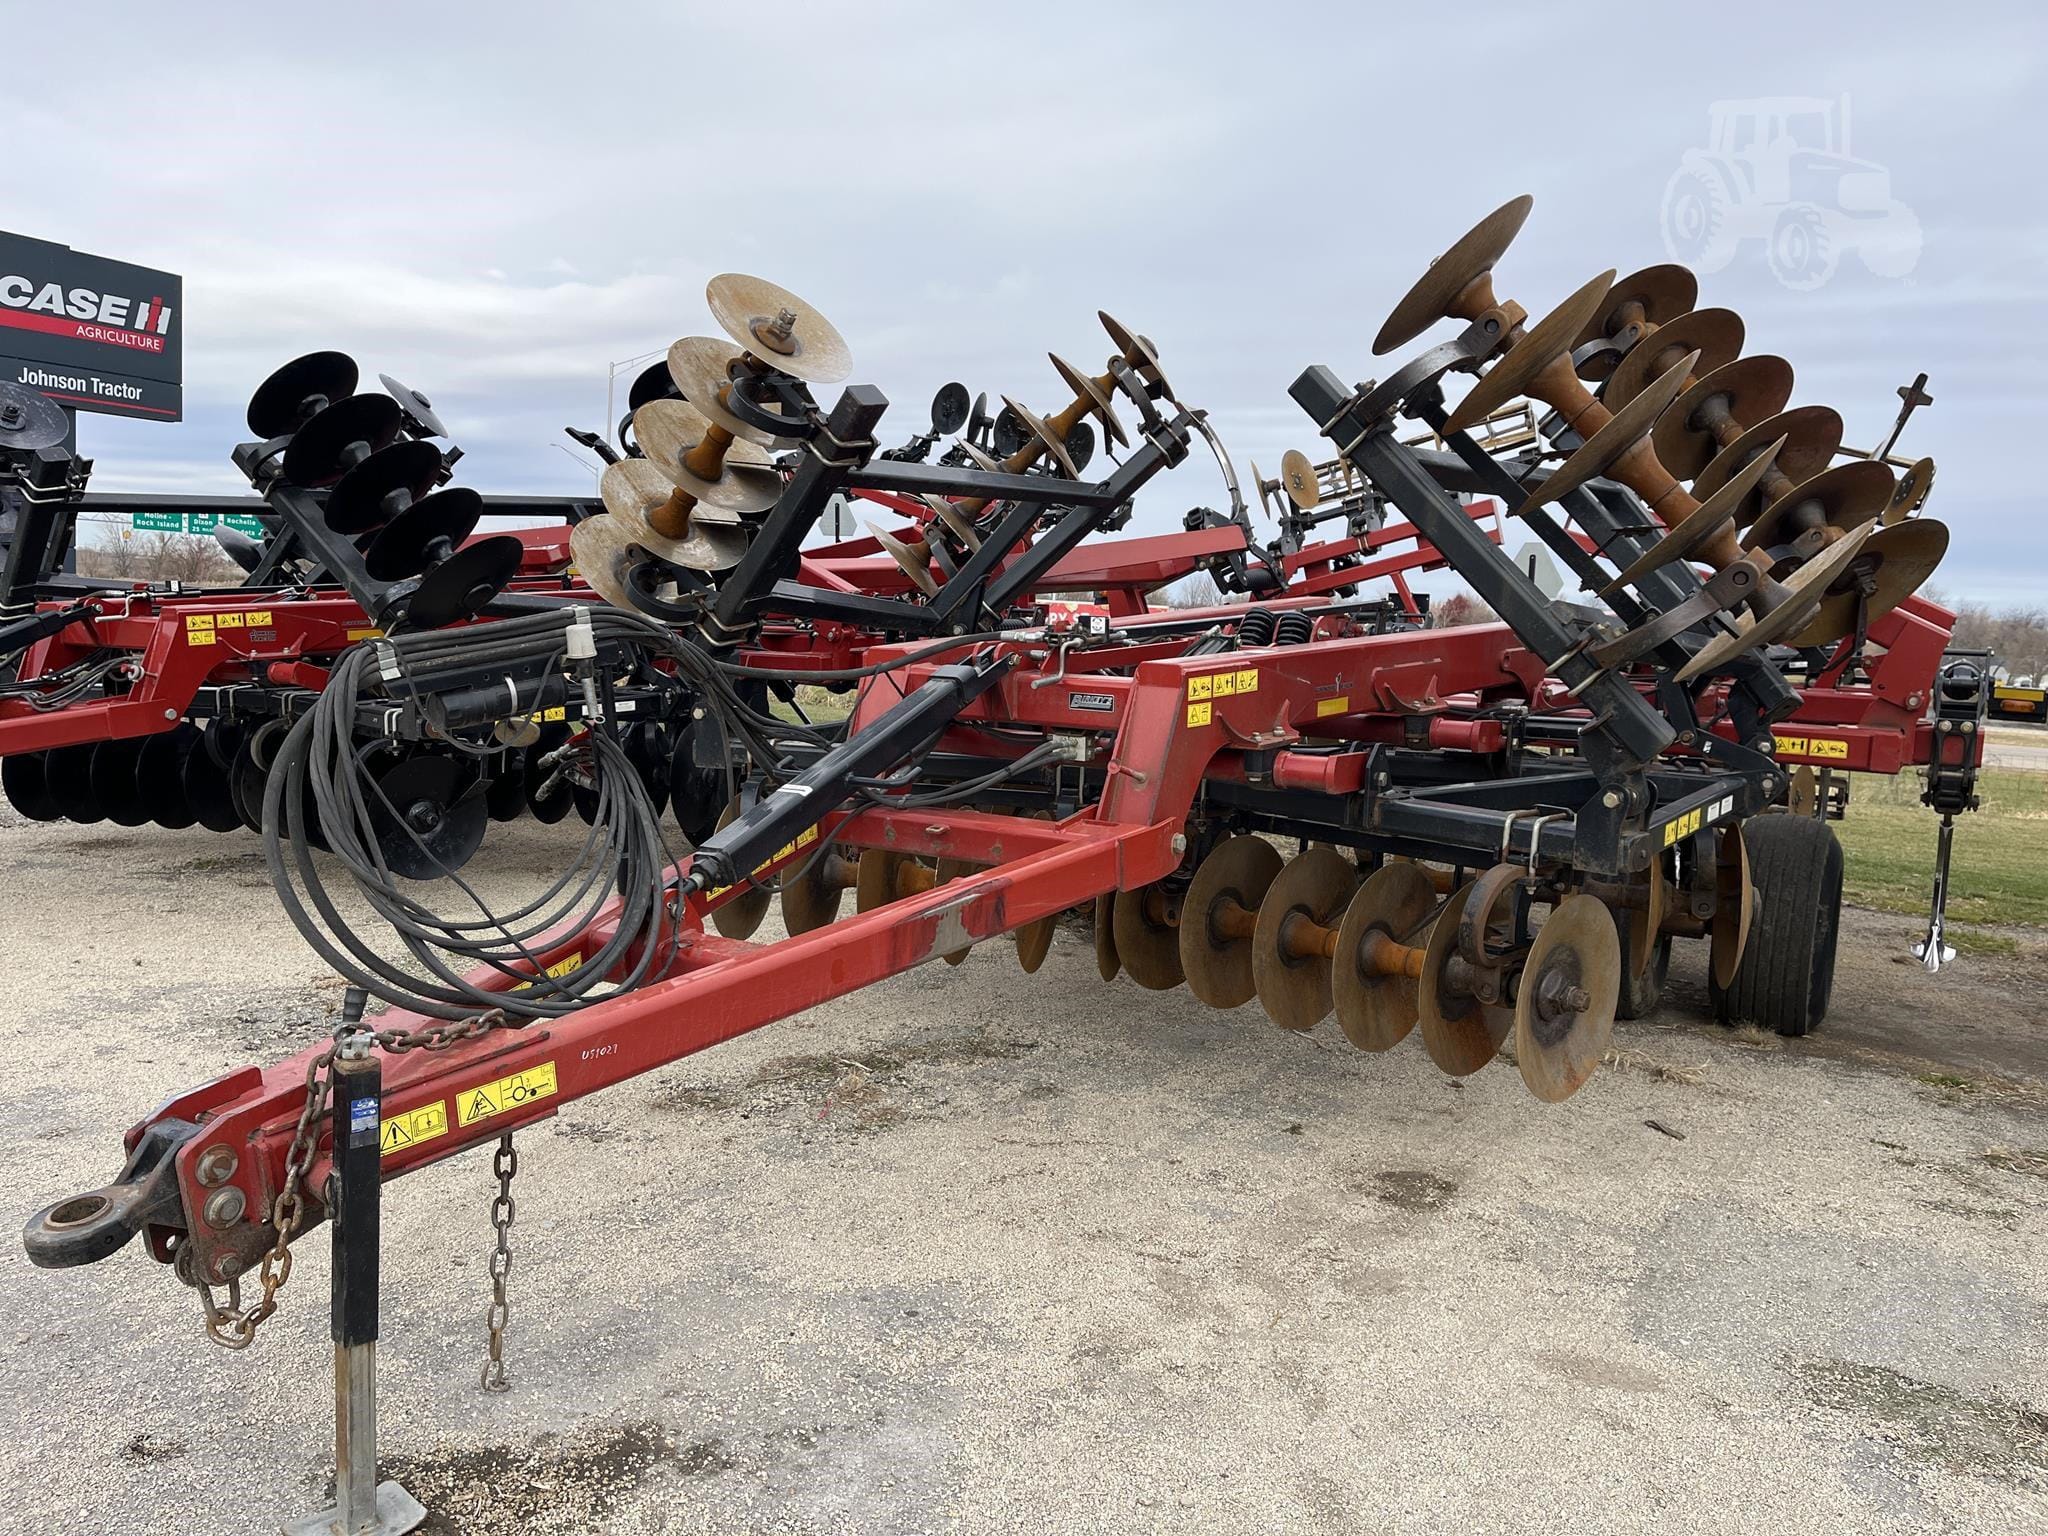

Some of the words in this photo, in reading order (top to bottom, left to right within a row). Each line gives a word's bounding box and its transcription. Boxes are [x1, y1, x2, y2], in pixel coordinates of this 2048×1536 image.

[0, 275, 131, 326] CASE
[76, 326, 160, 350] AGRICULTURE
[18, 367, 86, 392] Johnson
[90, 378, 142, 400] Tractor
[226, 518, 256, 526] Rochelle
